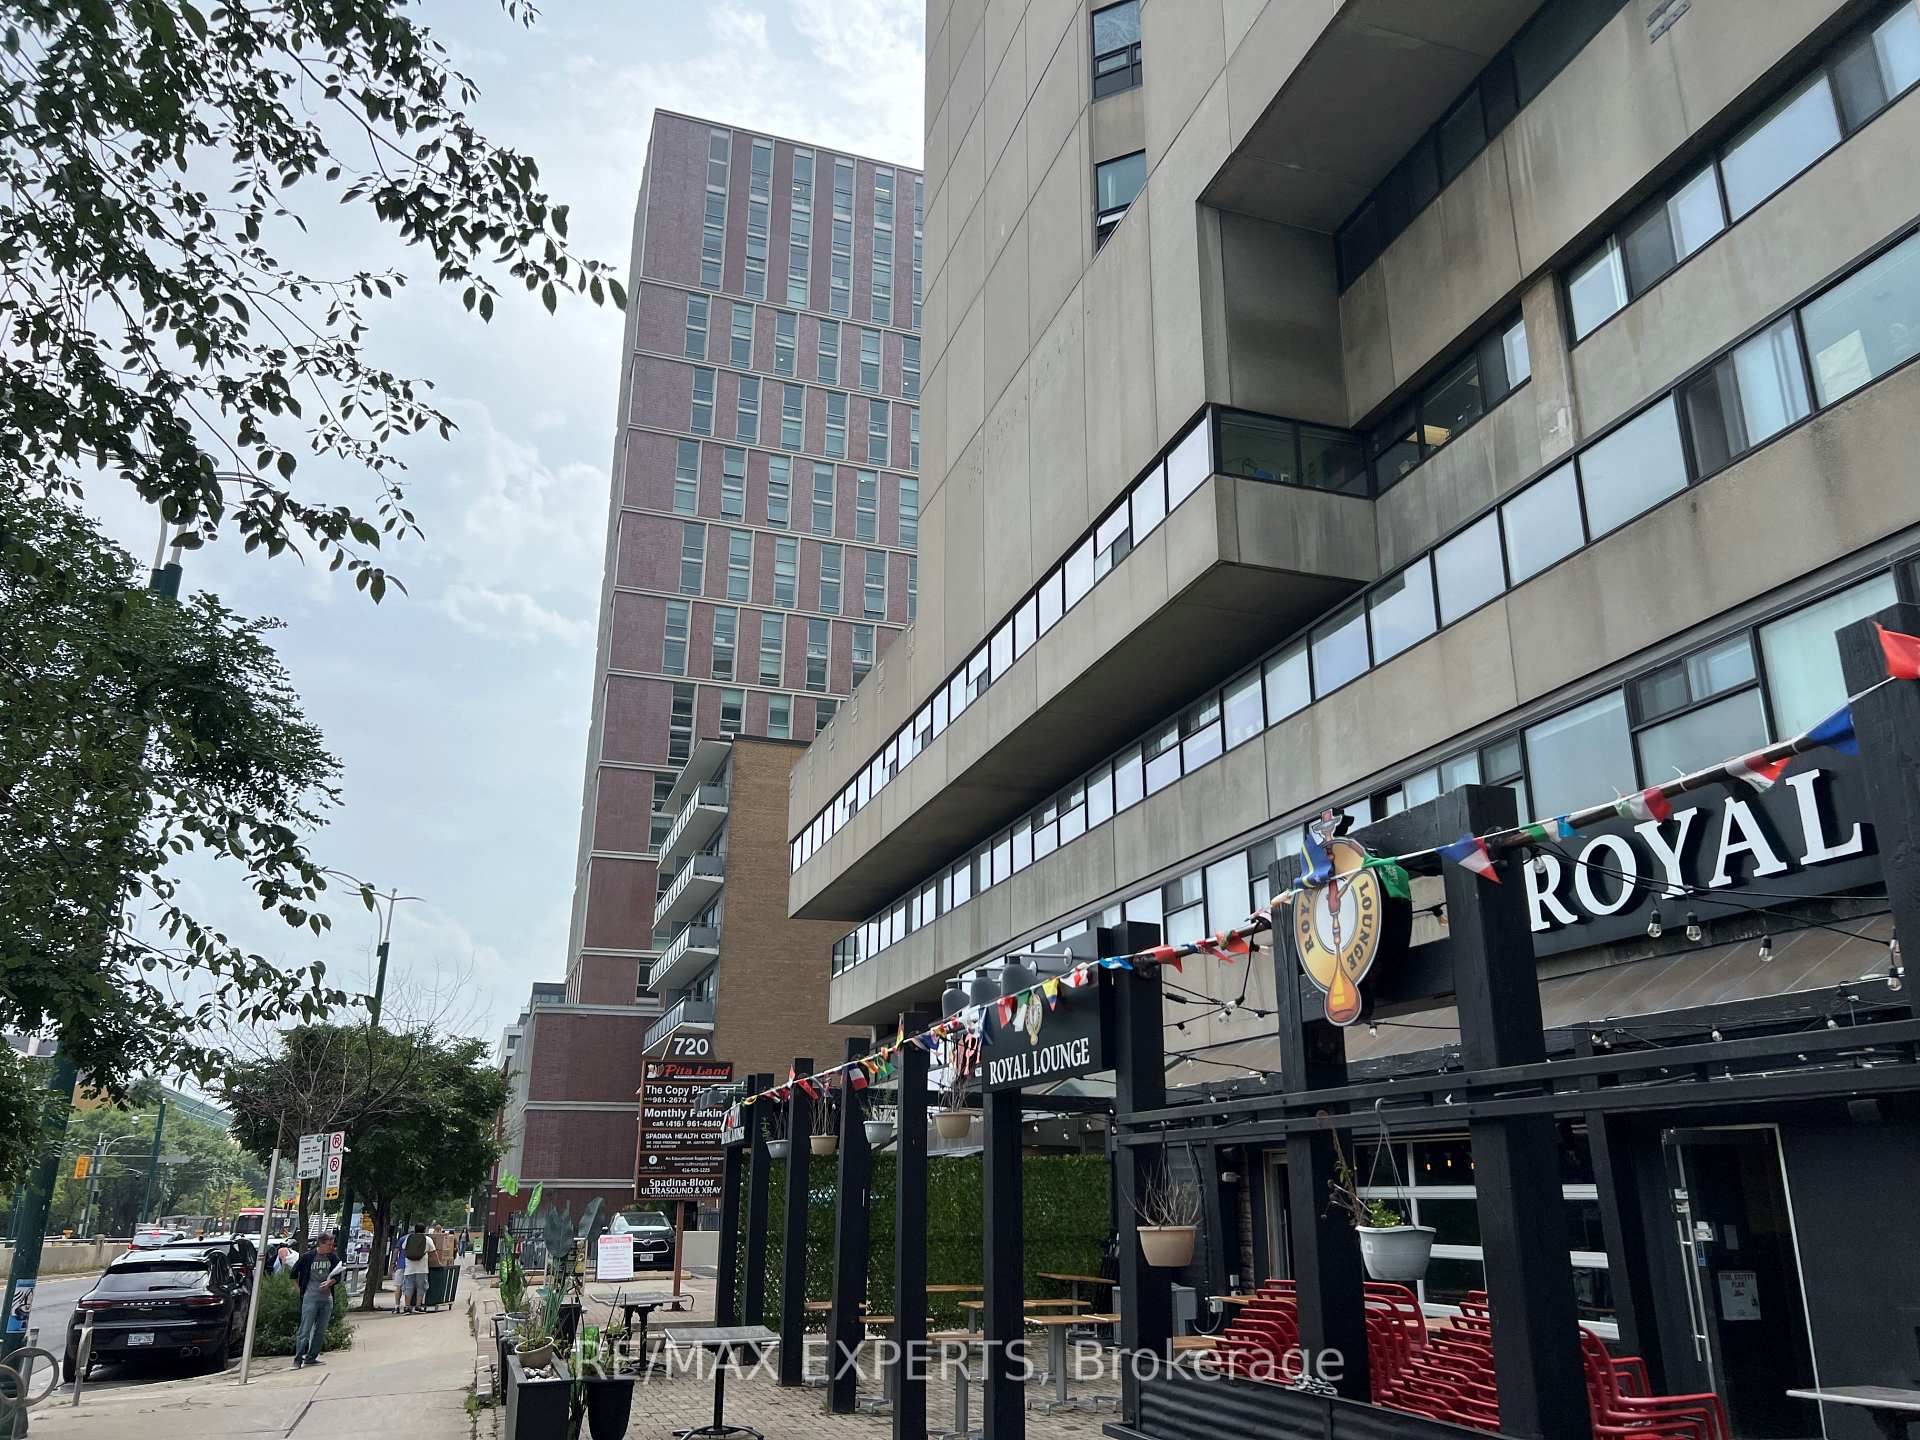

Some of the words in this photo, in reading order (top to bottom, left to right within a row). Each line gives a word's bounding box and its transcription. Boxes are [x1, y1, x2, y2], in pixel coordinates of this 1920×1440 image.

[1523, 768, 1863, 932] ROYAL
[1347, 880, 1373, 970] LOUNGE
[674, 1038, 709, 1055] 720
[989, 1053, 1030, 1085] ROYAL
[1032, 1037, 1090, 1076] LOUNGE
[664, 1064, 693, 1077] Pita
[695, 1065, 732, 1076] Land
[645, 1084, 663, 1095] The
[665, 1084, 689, 1098] Copy
[644, 1108, 687, 1119] Monthly
[690, 1109, 722, 1118] Parkin
[641, 1187, 693, 1195] ULTRASOUND
[701, 1186, 721, 1194] XRAY
